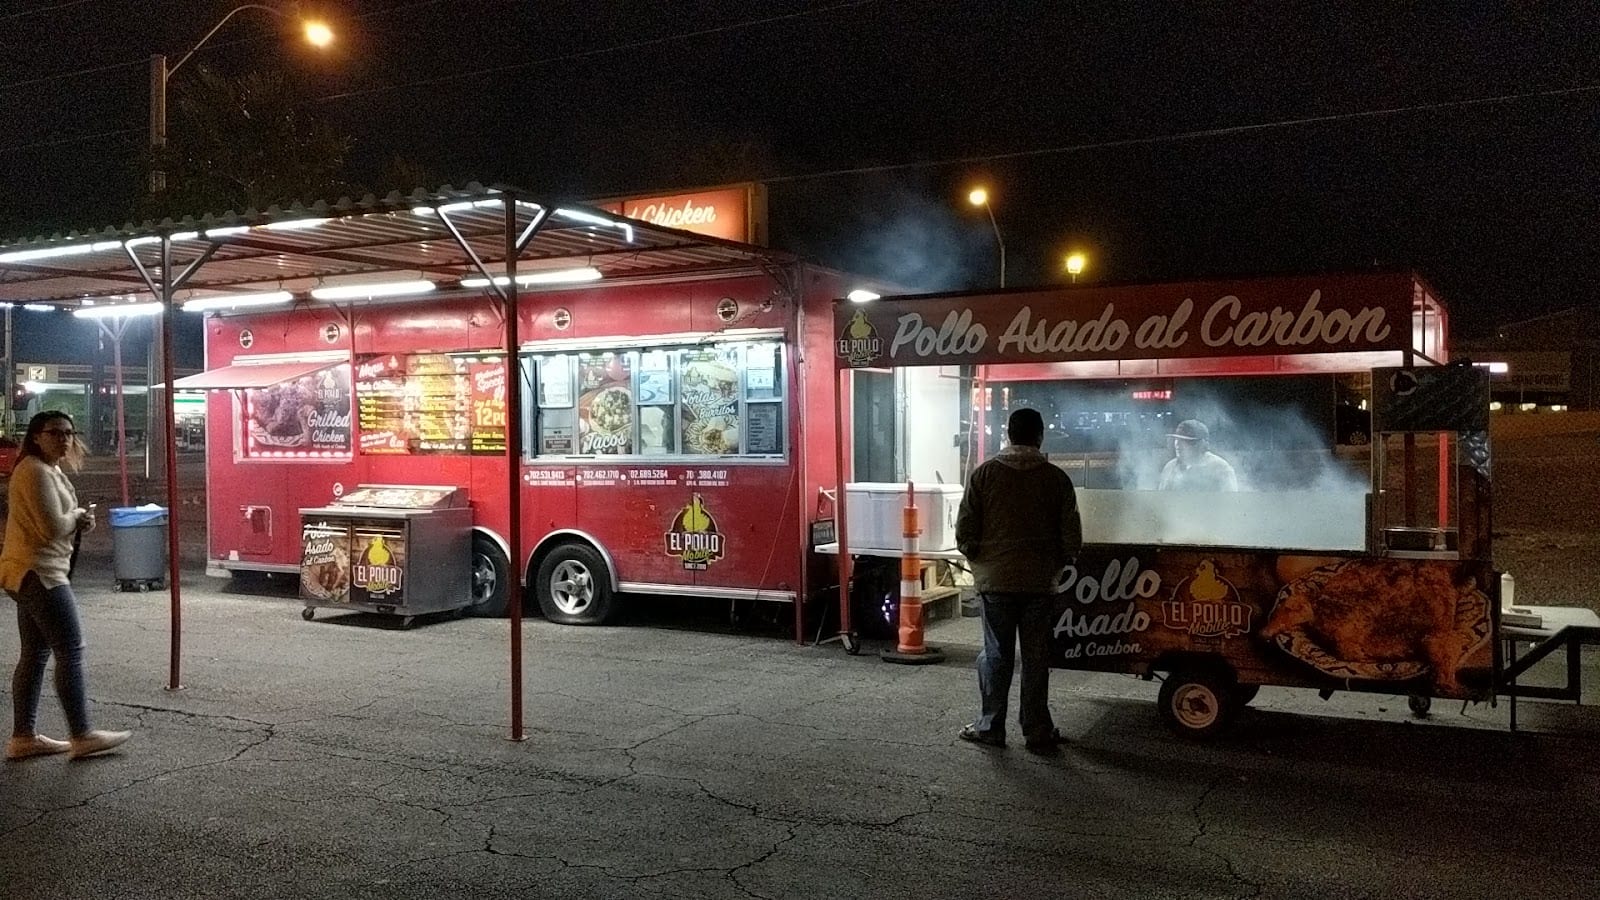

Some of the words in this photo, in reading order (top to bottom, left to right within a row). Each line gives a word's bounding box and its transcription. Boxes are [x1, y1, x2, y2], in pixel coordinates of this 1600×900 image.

[641, 200, 716, 226] Chicken
[890, 308, 988, 358] Pollo
[998, 303, 1130, 354] Asado
[1134, 298, 1194, 349] al
[1200, 289, 1391, 347] Carbon
[840, 339, 850, 354] EL
[851, 338, 879, 353] POLLO
[684, 391, 716, 405] Tortas
[308, 409, 351, 428] Grilled
[699, 405, 736, 419] Burritos
[312, 429, 346, 443] Chicken
[588, 432, 627, 450] Tacos
[305, 539, 334, 555] Asado
[670, 533, 683, 551] EL
[684, 533, 719, 553] POLLO
[358, 565, 368, 582] EL
[369, 566, 397, 584] POLLO
[1053, 601, 1151, 639] Asado
[1171, 601, 1188, 623] EL
[1192, 602, 1242, 626] POLLO
[1188, 617, 1231, 635] Mobile
[1064, 643, 1082, 659] al
[1086, 639, 1142, 657] Carbon
